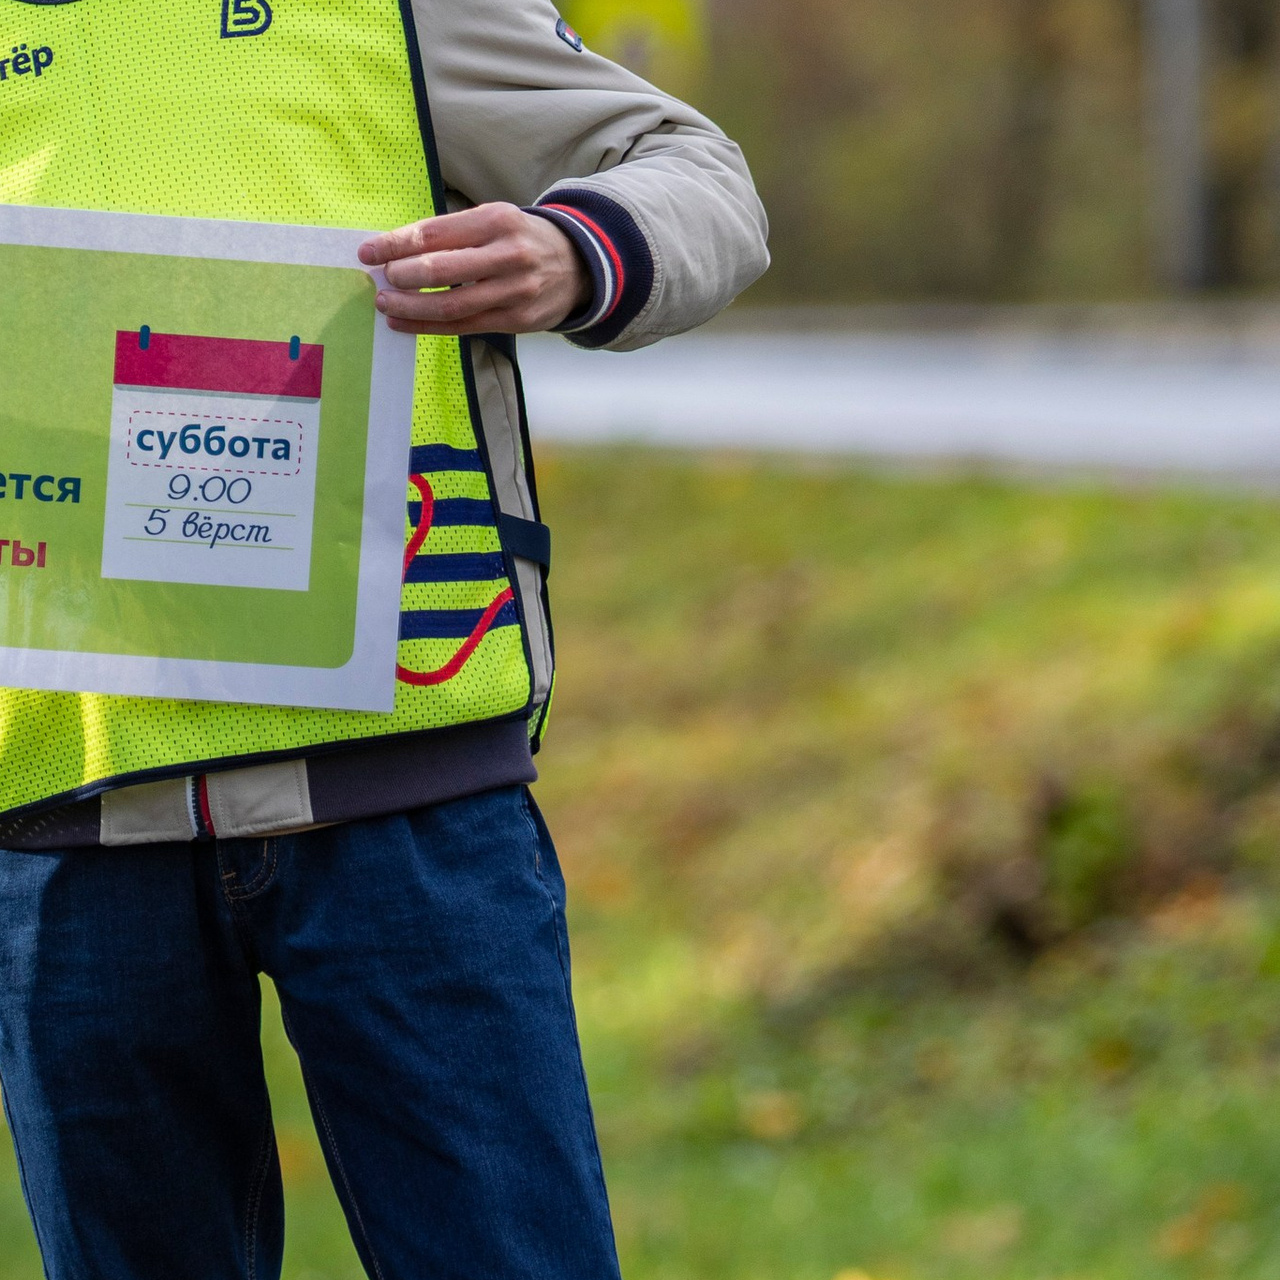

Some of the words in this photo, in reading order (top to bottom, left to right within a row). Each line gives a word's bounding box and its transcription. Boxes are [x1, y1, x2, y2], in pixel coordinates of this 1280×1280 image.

[136, 423, 291, 461] суббота
[167, 473, 252, 504] 9:00
[143, 508, 171, 536] 5
[181, 511, 273, 549] вёрст
